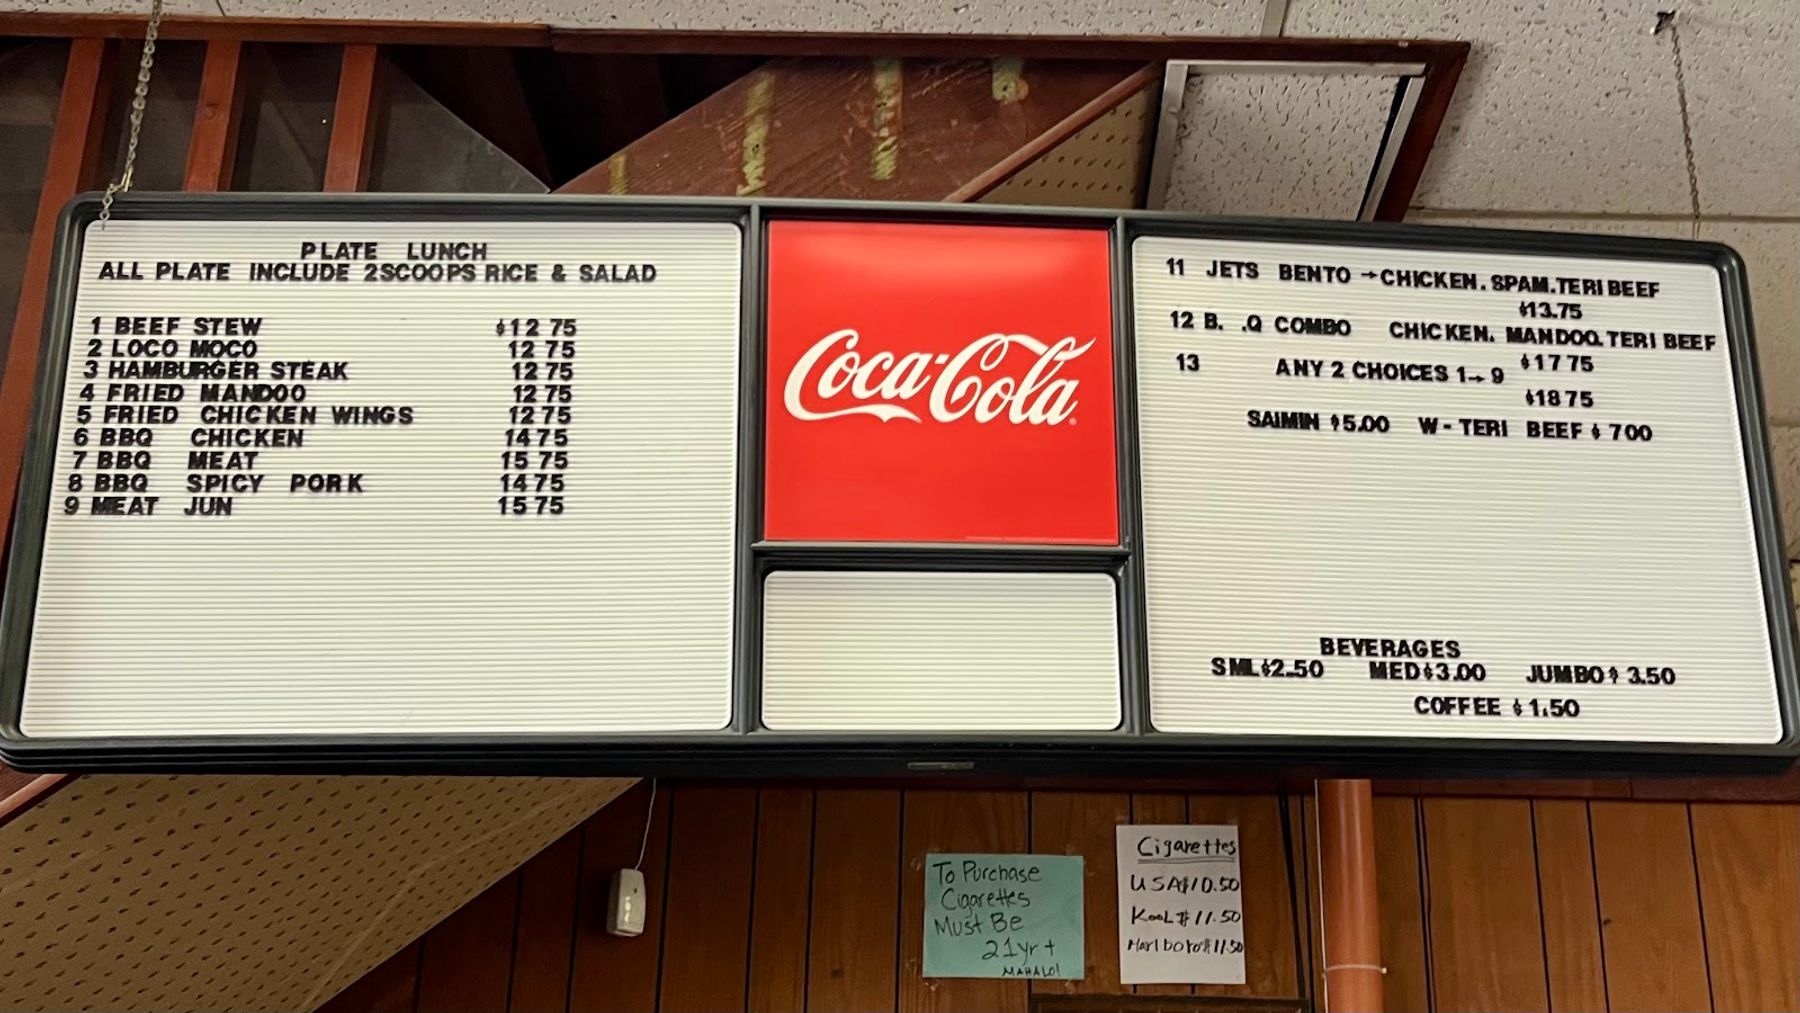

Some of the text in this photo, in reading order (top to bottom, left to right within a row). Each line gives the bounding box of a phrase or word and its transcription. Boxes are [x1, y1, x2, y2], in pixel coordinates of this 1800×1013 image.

[300, 241, 487, 261] PLATE LUNCH
[98, 261, 144, 281] ALL
[155, 261, 231, 281] PLATE
[249, 262, 350, 282] INCLUDE
[485, 263, 538, 282] RICE
[551, 263, 567, 282] &
[579, 264, 657, 282] SALAD
[1166, 257, 1184, 276] 11
[1206, 260, 1259, 280] JETS
[1278, 263, 1351, 284] BENTO
[1607, 279, 1660, 298] BEEF
[1518, 301, 1583, 320] $13.75
[91, 316, 102, 335] 1
[114, 316, 181, 336] BEEF
[193, 317, 263, 337] STEW
[1274, 315, 1352, 337] COMBO
[1663, 332, 1717, 351] BEEF
[87, 338, 103, 358] 2
[111, 338, 179, 358] LOCO
[189, 339, 258, 359] MOCO
[83, 359, 99, 380] 3
[108, 359, 260, 380] HAMBURGER
[270, 360, 349, 381] STEAK
[784, 328, 1096, 425] Coca-Cola
[1176, 353, 1505, 385] 13 ANY 2 CHOICES 1 9
[79, 382, 95, 402] 4
[106, 383, 185, 403] FRIED
[200, 383, 307, 403] MANDOO
[77, 404, 92, 425] 5
[103, 404, 179, 425] FRIED
[200, 404, 317, 425] CHICKEN
[331, 405, 414, 425] WINGS
[1247, 409, 1320, 431] SAIMIN
[1458, 418, 1508, 438] TERI
[1526, 420, 1583, 440] BEEF
[73, 427, 89, 447] 6
[99, 427, 154, 447] BBQ
[190, 427, 305, 448] CHICKEN
[73, 450, 88, 470] 7
[96, 450, 152, 470] BBQ
[187, 450, 260, 471] MEAT
[67, 473, 83, 493] 8
[93, 473, 149, 493] BBQ
[186, 473, 265, 494] SPICY
[290, 473, 364, 493] PORK
[63, 495, 80, 516] 9
[90, 496, 160, 516] MEAT
[183, 496, 234, 516] JUN
[1319, 637, 1461, 659] BEVERAGES
[1414, 695, 1502, 716] COFFEE
[1137, 836, 1236, 857] Cigarettes
[932, 860, 1042, 886] To Purchase
[941, 888, 1031, 918] Cigarettes
[934, 912, 1024, 937] Must Be
